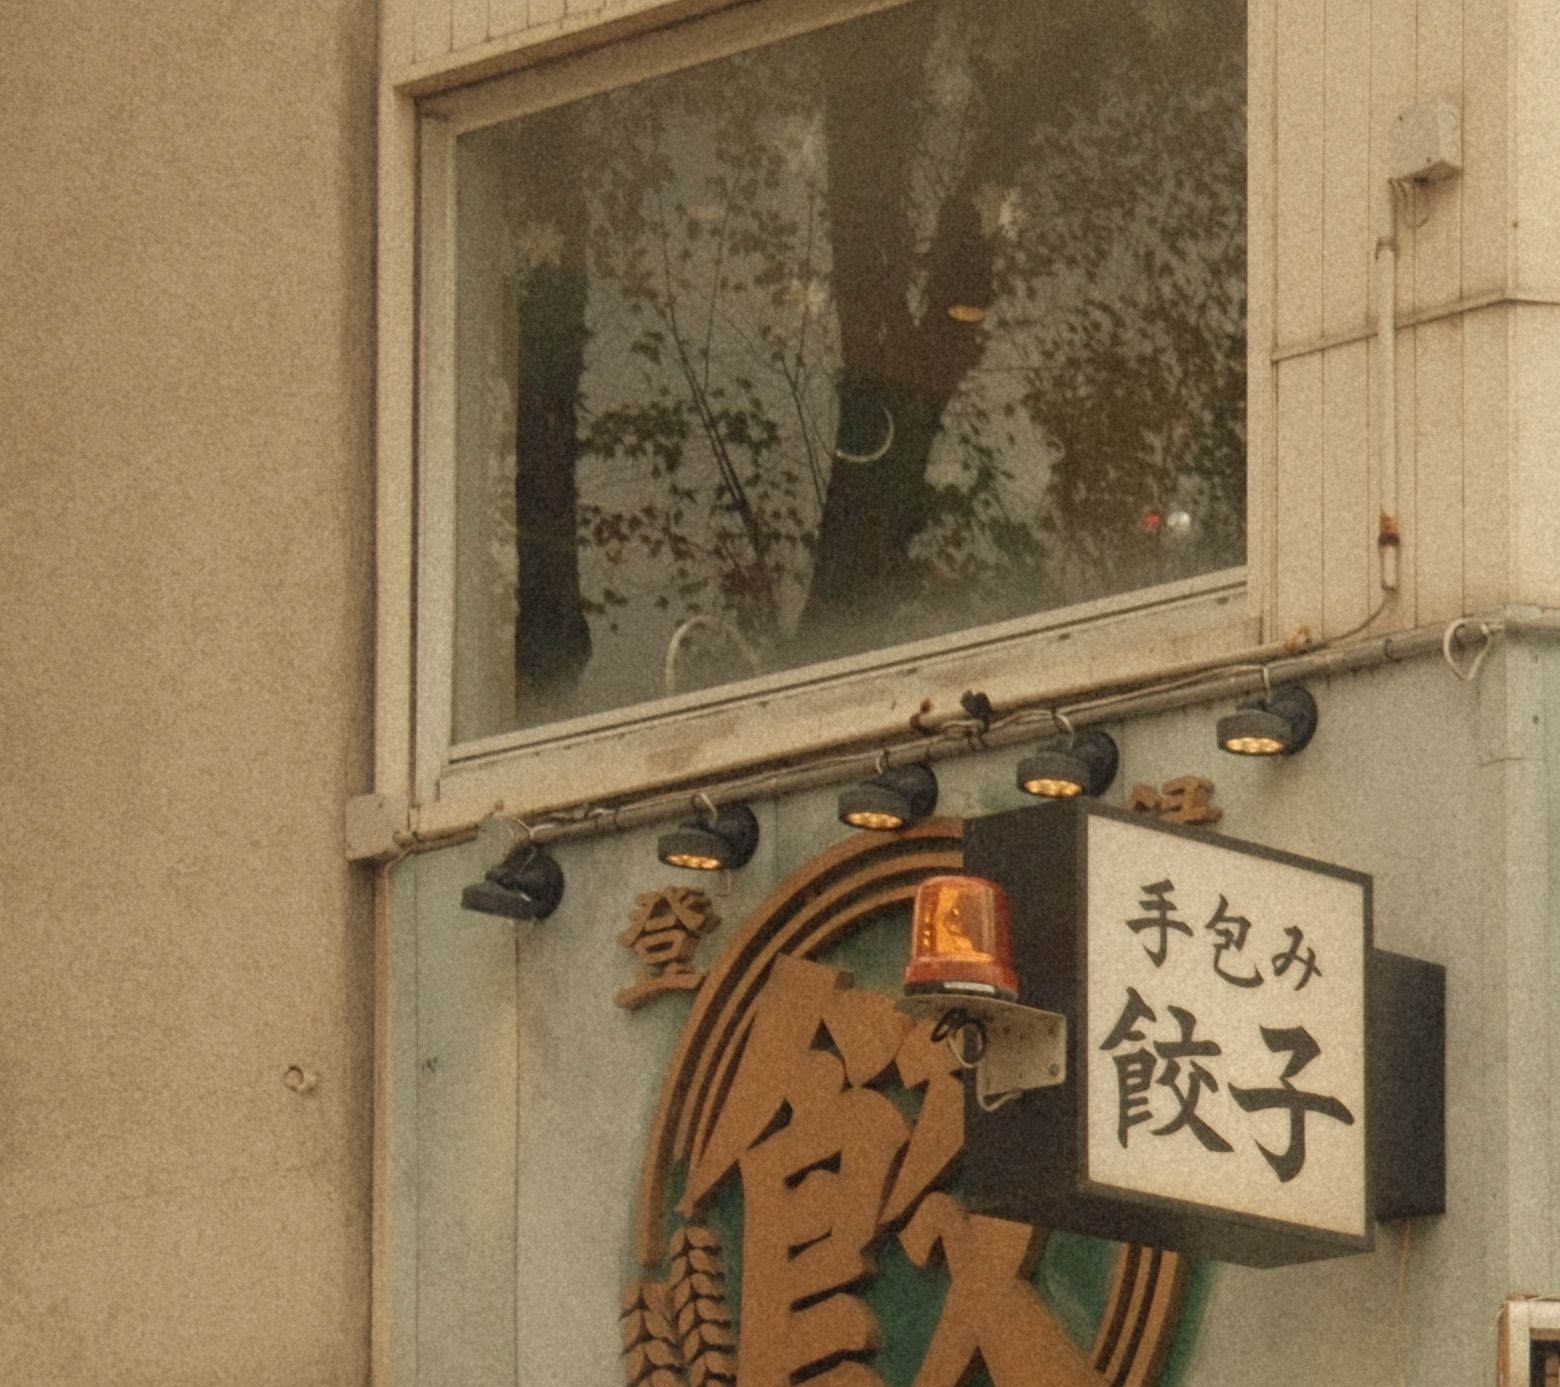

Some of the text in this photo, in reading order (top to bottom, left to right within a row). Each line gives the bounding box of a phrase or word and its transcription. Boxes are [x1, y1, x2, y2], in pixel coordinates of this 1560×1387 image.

[616, 885, 718, 1010] 登
[1125, 879, 1325, 994] 手包み
[1098, 986, 1356, 1185] 餃子
